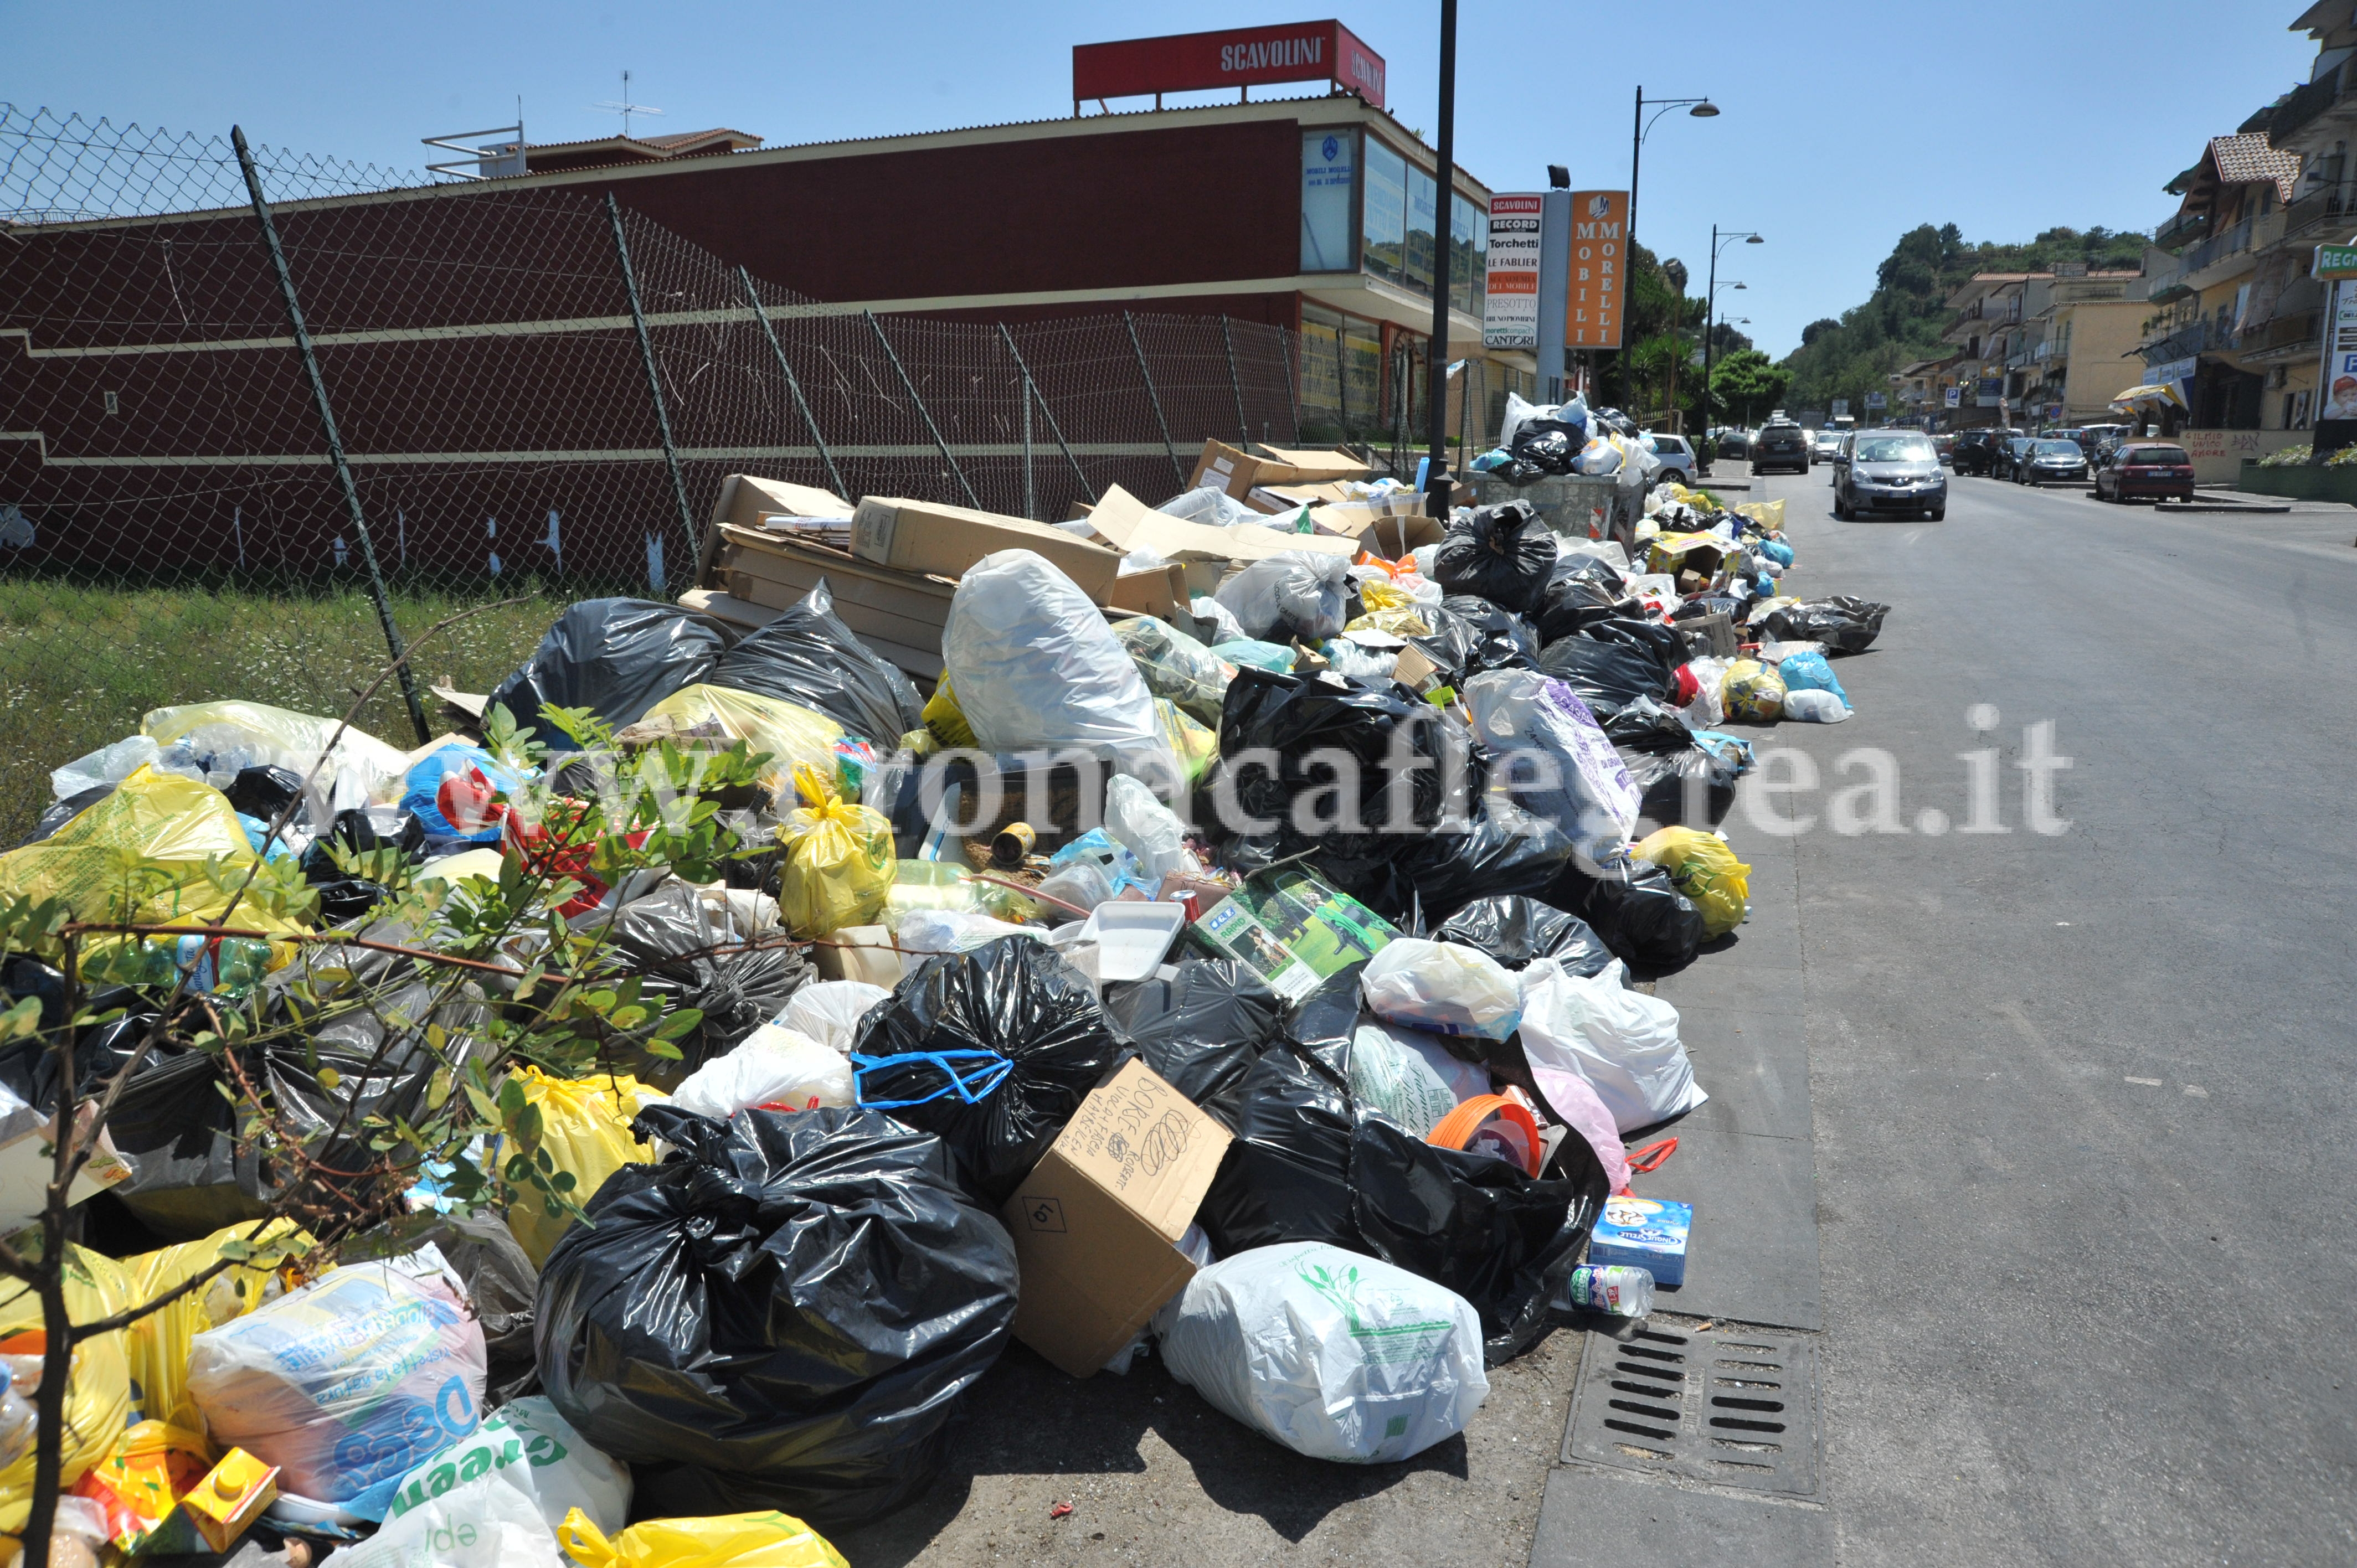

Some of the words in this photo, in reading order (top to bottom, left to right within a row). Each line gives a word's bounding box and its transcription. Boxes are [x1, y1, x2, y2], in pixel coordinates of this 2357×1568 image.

[1221, 37, 1321, 71] SCAVOLINI
[1351, 50, 1382, 95] SCAVOLINI
[1494, 200, 1537, 210] SCAVOLINI
[1493, 220, 1537, 229] RECORD
[1489, 239, 1538, 249] Torchetti
[1488, 259, 1496, 267] LE
[1500, 258, 1537, 266] FABLIER
[1576, 222, 1597, 342] MOBILI
[1598, 221, 1620, 343] MORELLI
[1487, 299, 1536, 308] PRESOTTO
[1485, 336, 1535, 345] CANTORI
[1949, 390, 1956, 399] P
[1221, 917, 1246, 939] RAPID
[1577, 1268, 1589, 1303] Matese
[391, 1435, 568, 1518] Green
